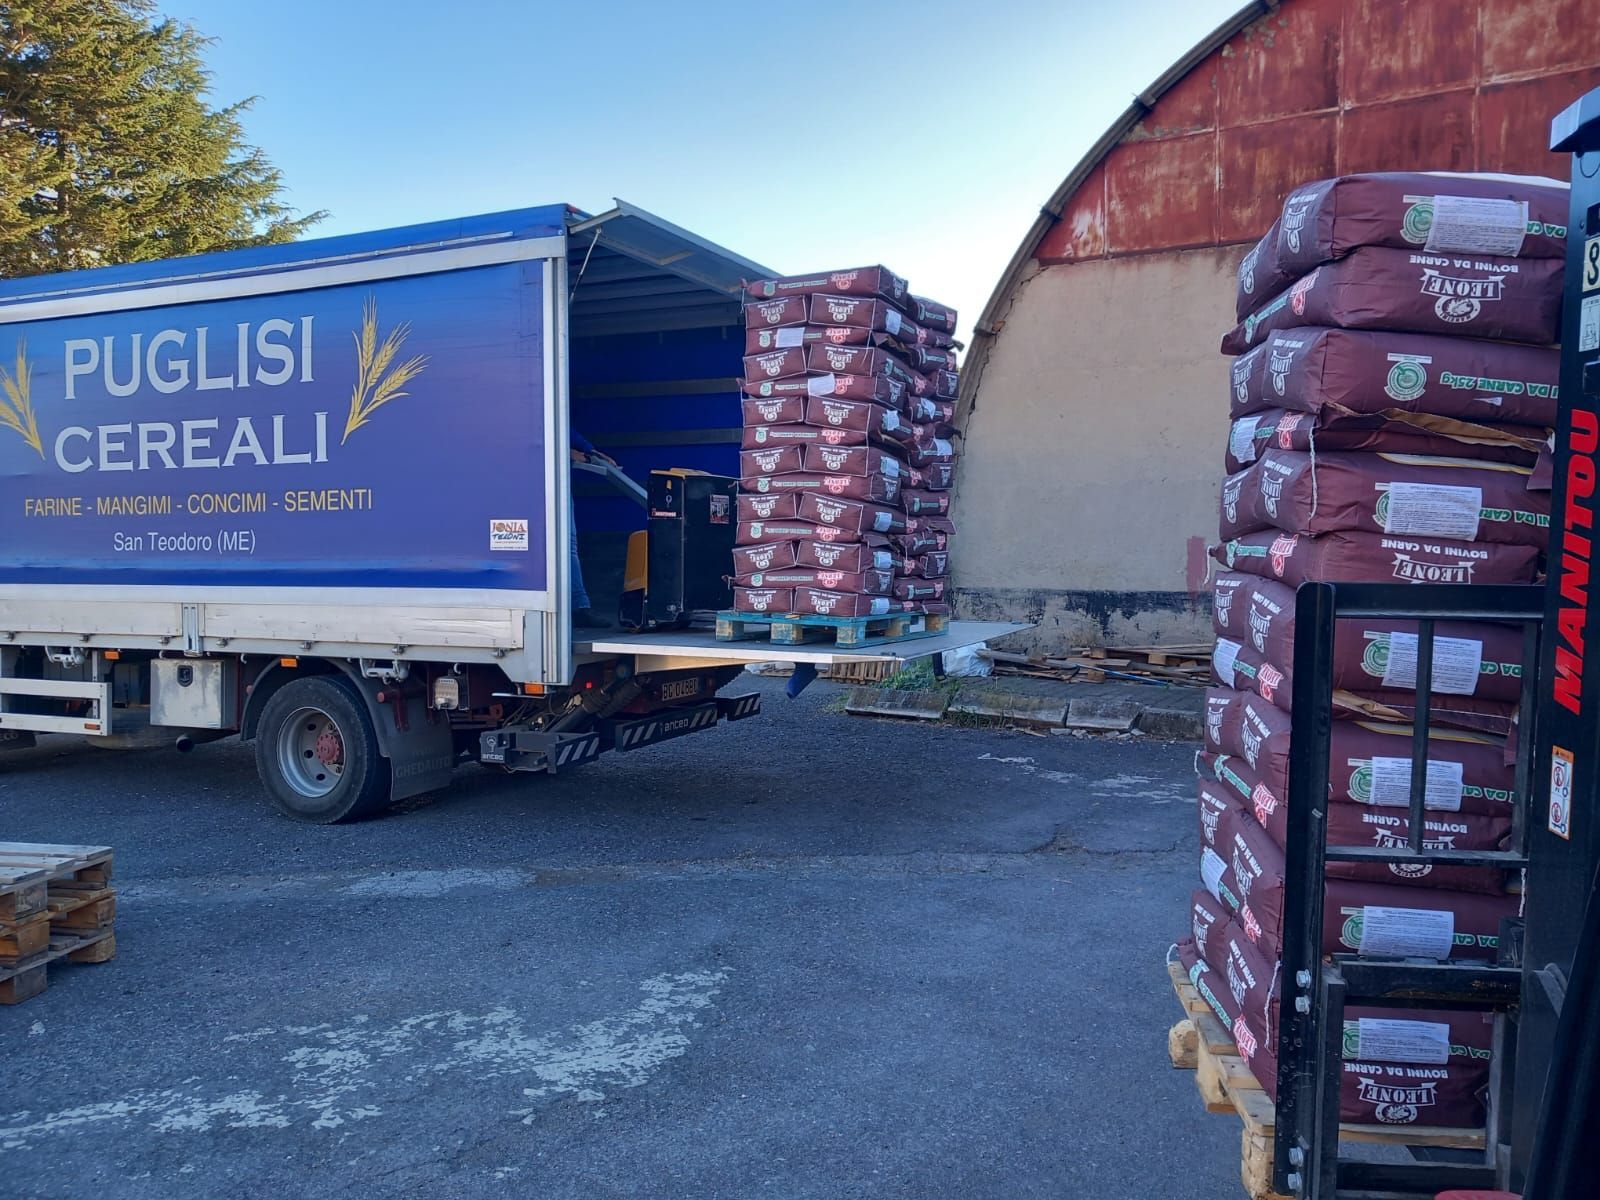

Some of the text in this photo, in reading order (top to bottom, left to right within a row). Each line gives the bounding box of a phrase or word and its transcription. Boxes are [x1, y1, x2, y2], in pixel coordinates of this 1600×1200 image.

[1409, 255, 1518, 273] BOVINI DA CARNE
[1429, 277, 1494, 297] LEONE
[63, 315, 314, 400] PUGLISI
[1440, 372, 1549, 397] DA CARNE 25kg
[53, 411, 328, 473] CEREALI
[24, 497, 82, 517] FARINE
[96, 494, 172, 515] MANGIMI
[187, 492, 267, 514] CONCIMI
[284, 489, 373, 511] SEMENTI
[1513, 511, 1535, 524] DA
[113, 530, 256, 554] San Teodoro (ME)
[1381, 539, 1488, 559] BOVINI DA CARNE
[1553, 408, 1598, 715] MANITOU
[1400, 562, 1464, 582] LEONE
[1362, 814, 1400, 826] CARNE
[1426, 822, 1467, 833] BOVINI
[1344, 1063, 1448, 1079] BOVINI DA CARNE
[1366, 1087, 1428, 1104] LEONE
